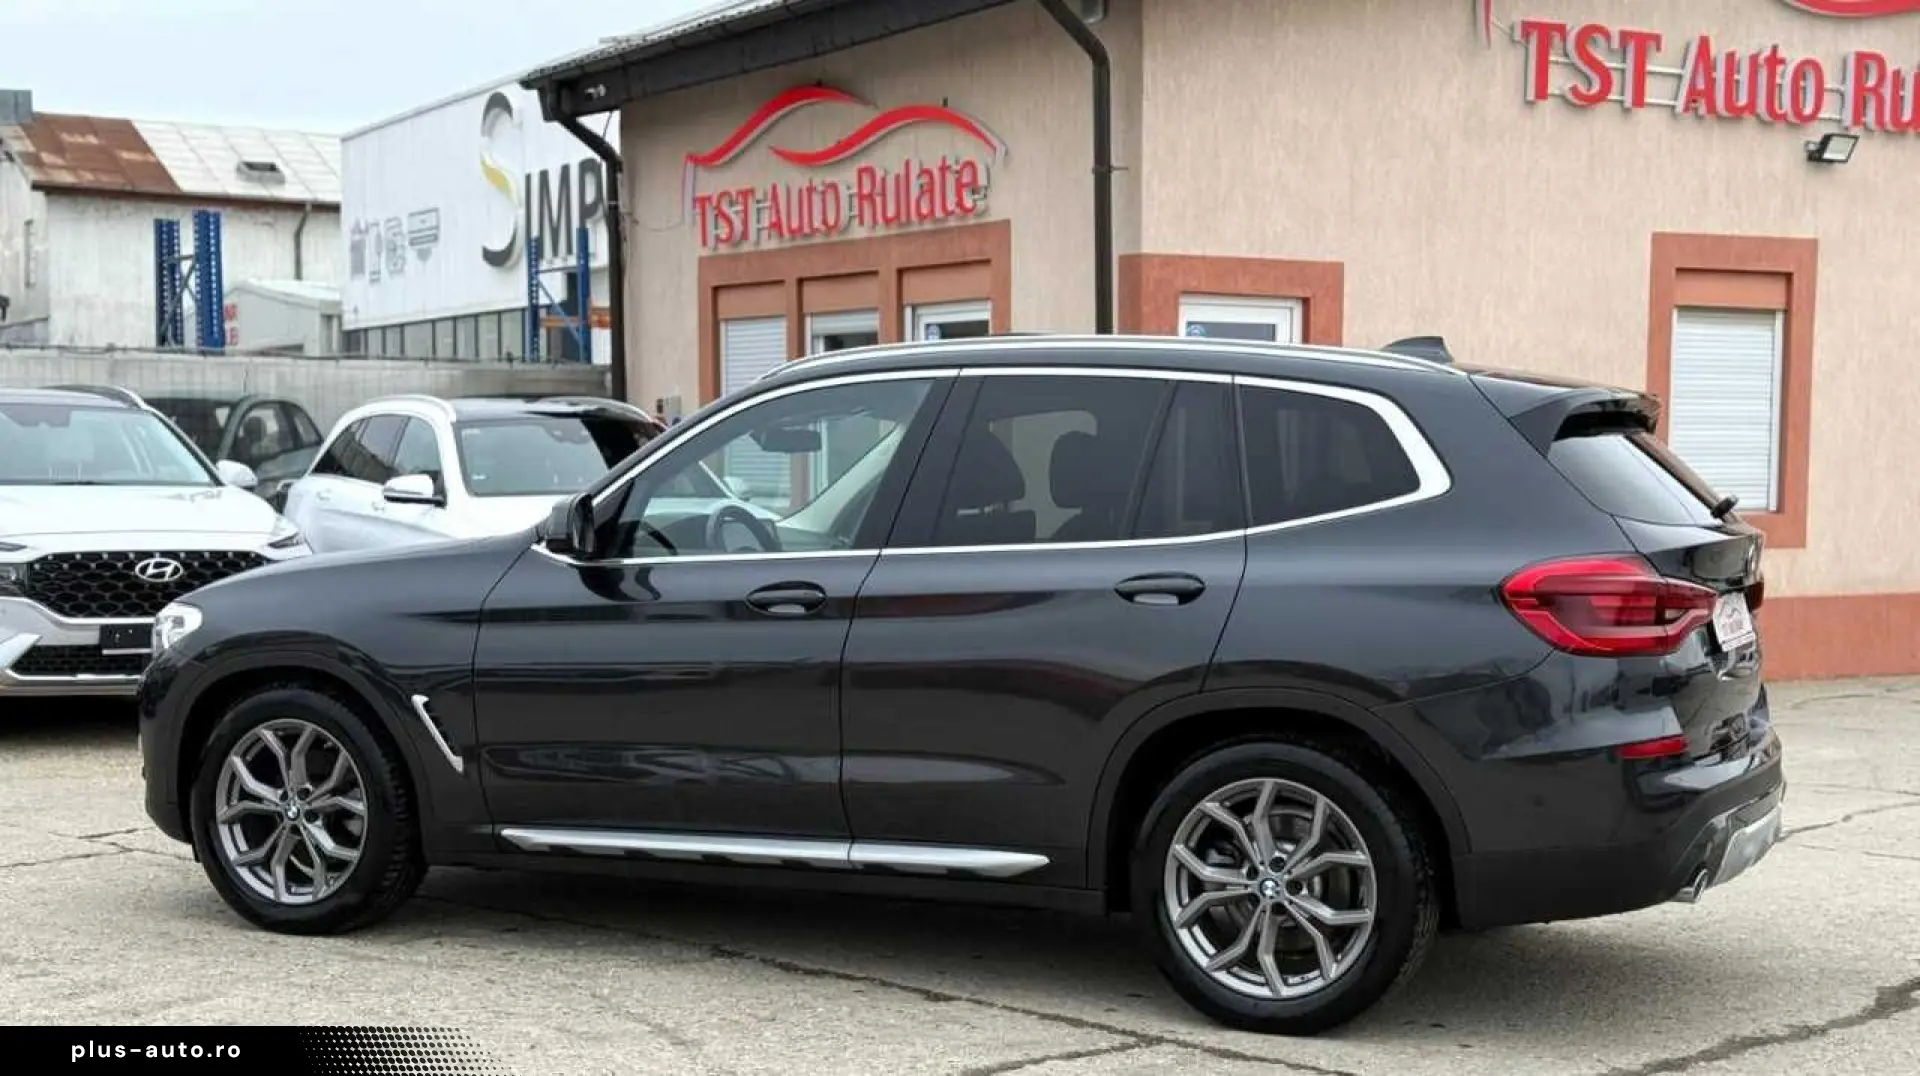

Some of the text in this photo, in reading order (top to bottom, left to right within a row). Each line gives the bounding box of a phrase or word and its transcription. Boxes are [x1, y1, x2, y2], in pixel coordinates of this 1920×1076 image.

[1521, 20, 1663, 109] TST
[1681, 35, 1825, 124] Auto
[693, 156, 981, 247] TST Auto Rulate
